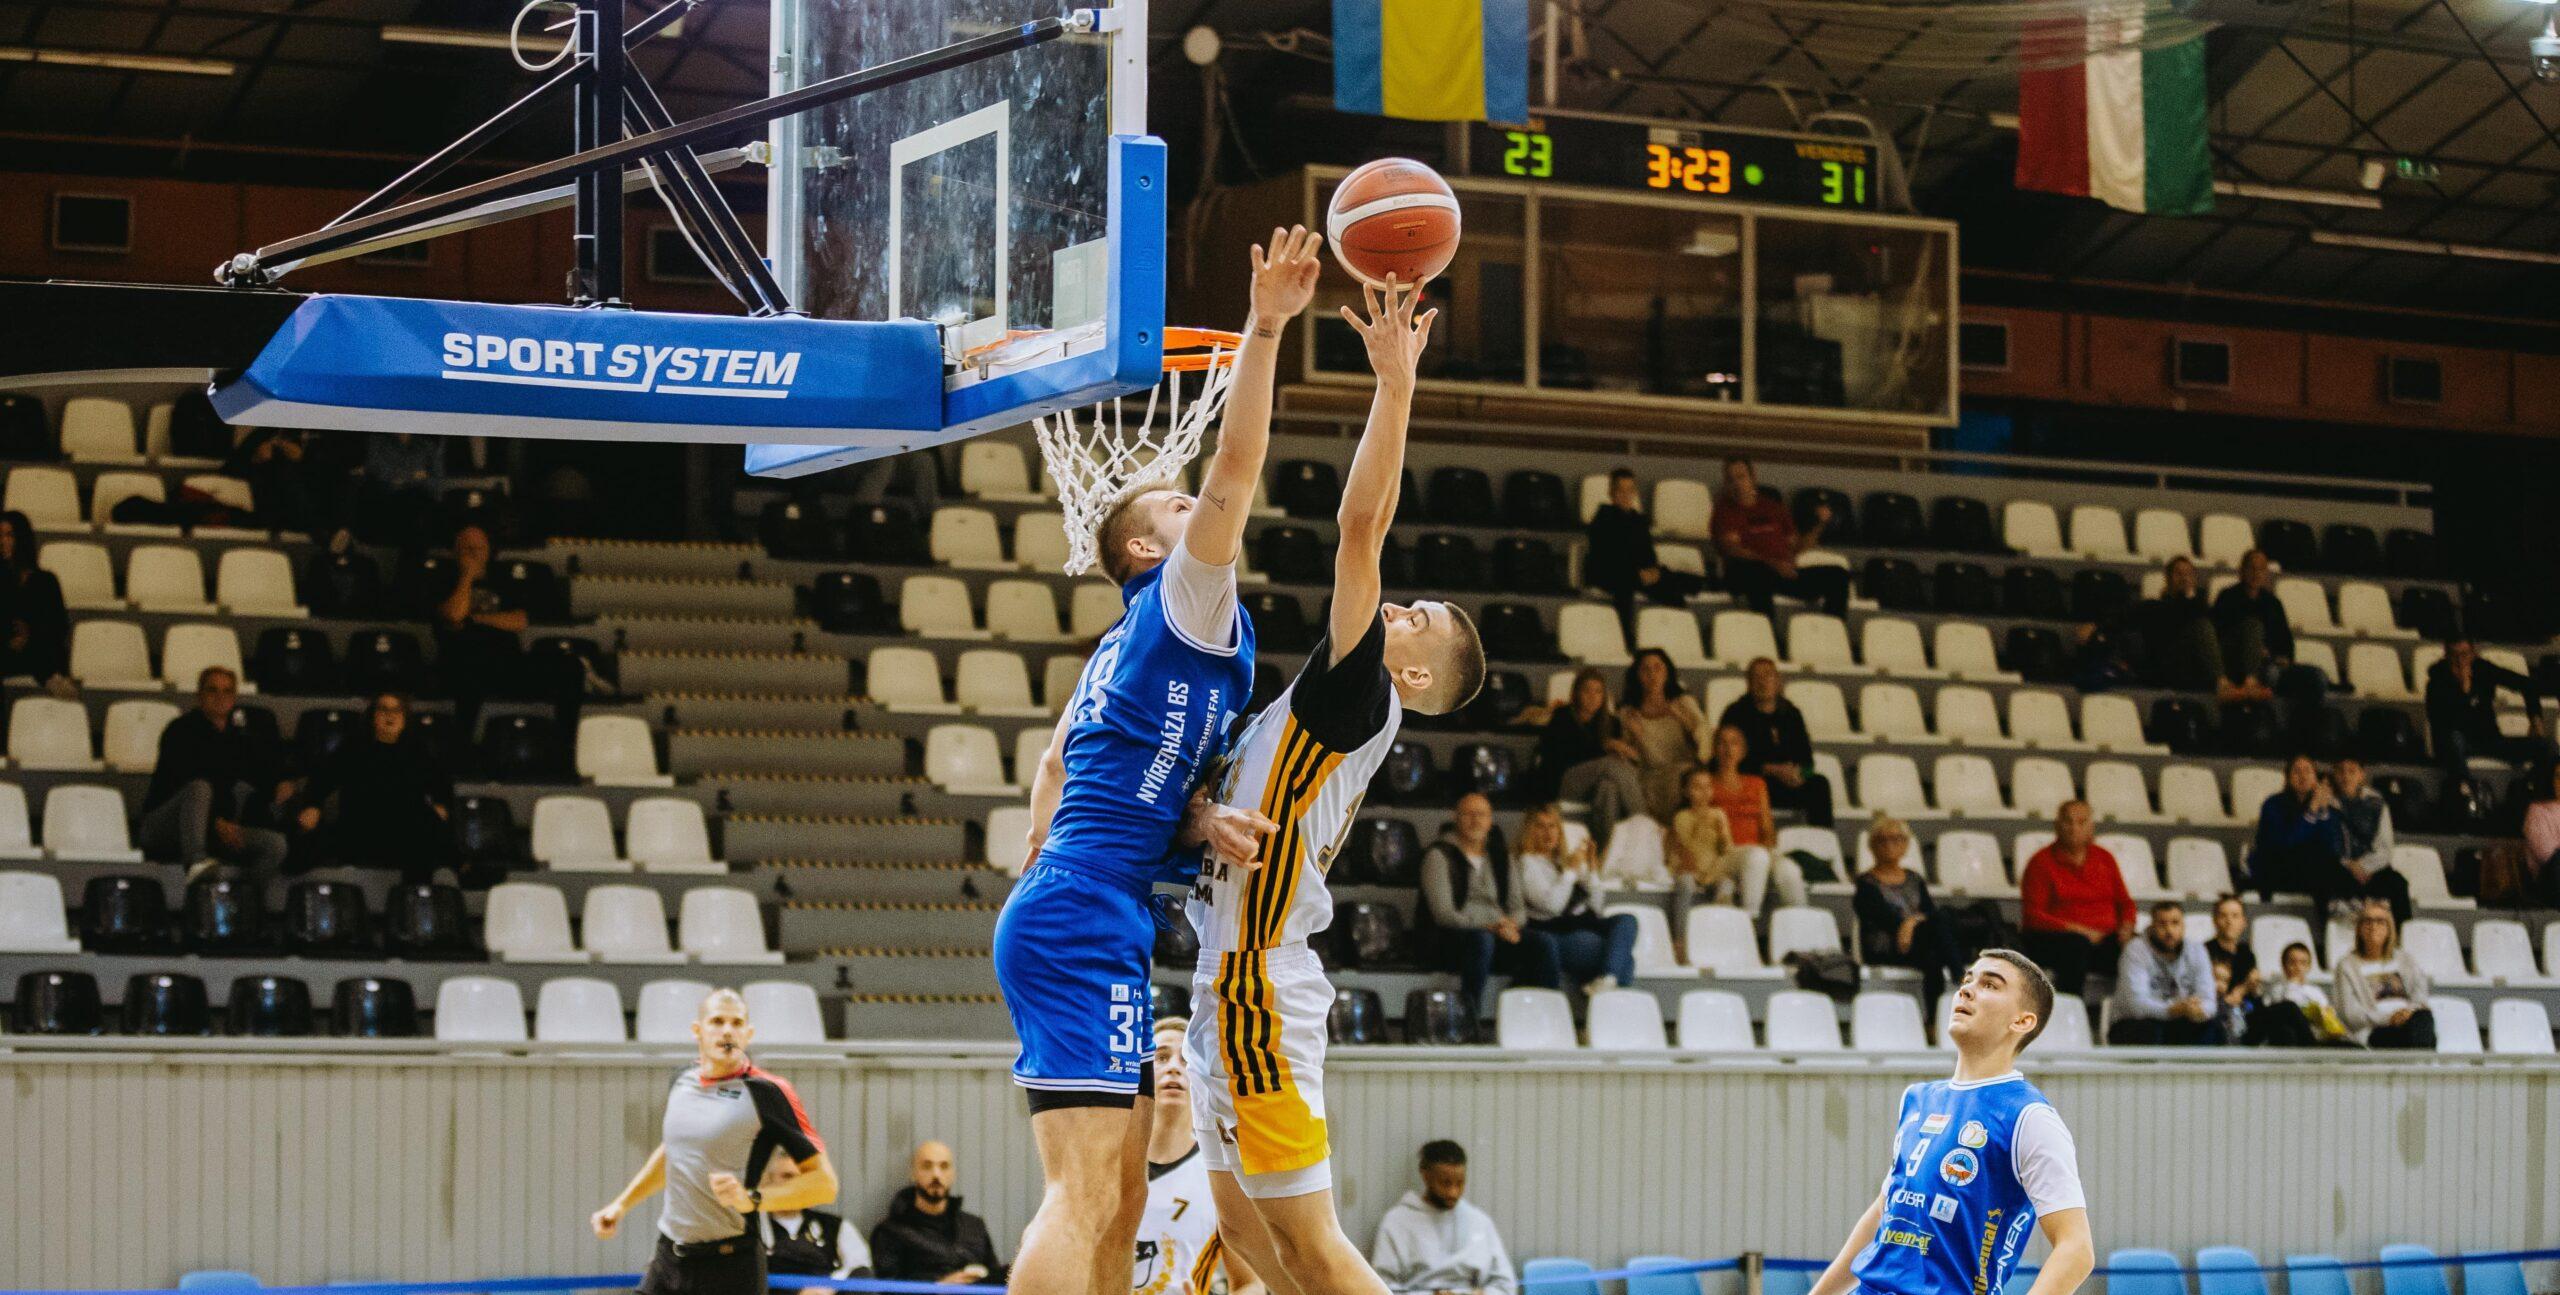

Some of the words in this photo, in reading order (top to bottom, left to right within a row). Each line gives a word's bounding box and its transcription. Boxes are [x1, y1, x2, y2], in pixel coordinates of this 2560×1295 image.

[1505, 131, 1552, 177] 23
[1647, 144, 1731, 194] 3:23
[1821, 161, 1866, 204] 31
[442, 332, 604, 376] SPORT
[606, 344, 801, 392] SYSTEM
[1168, 680, 1190, 707] BS
[1906, 1138, 1931, 1177] 9
[1171, 1197, 1190, 1222] 7
